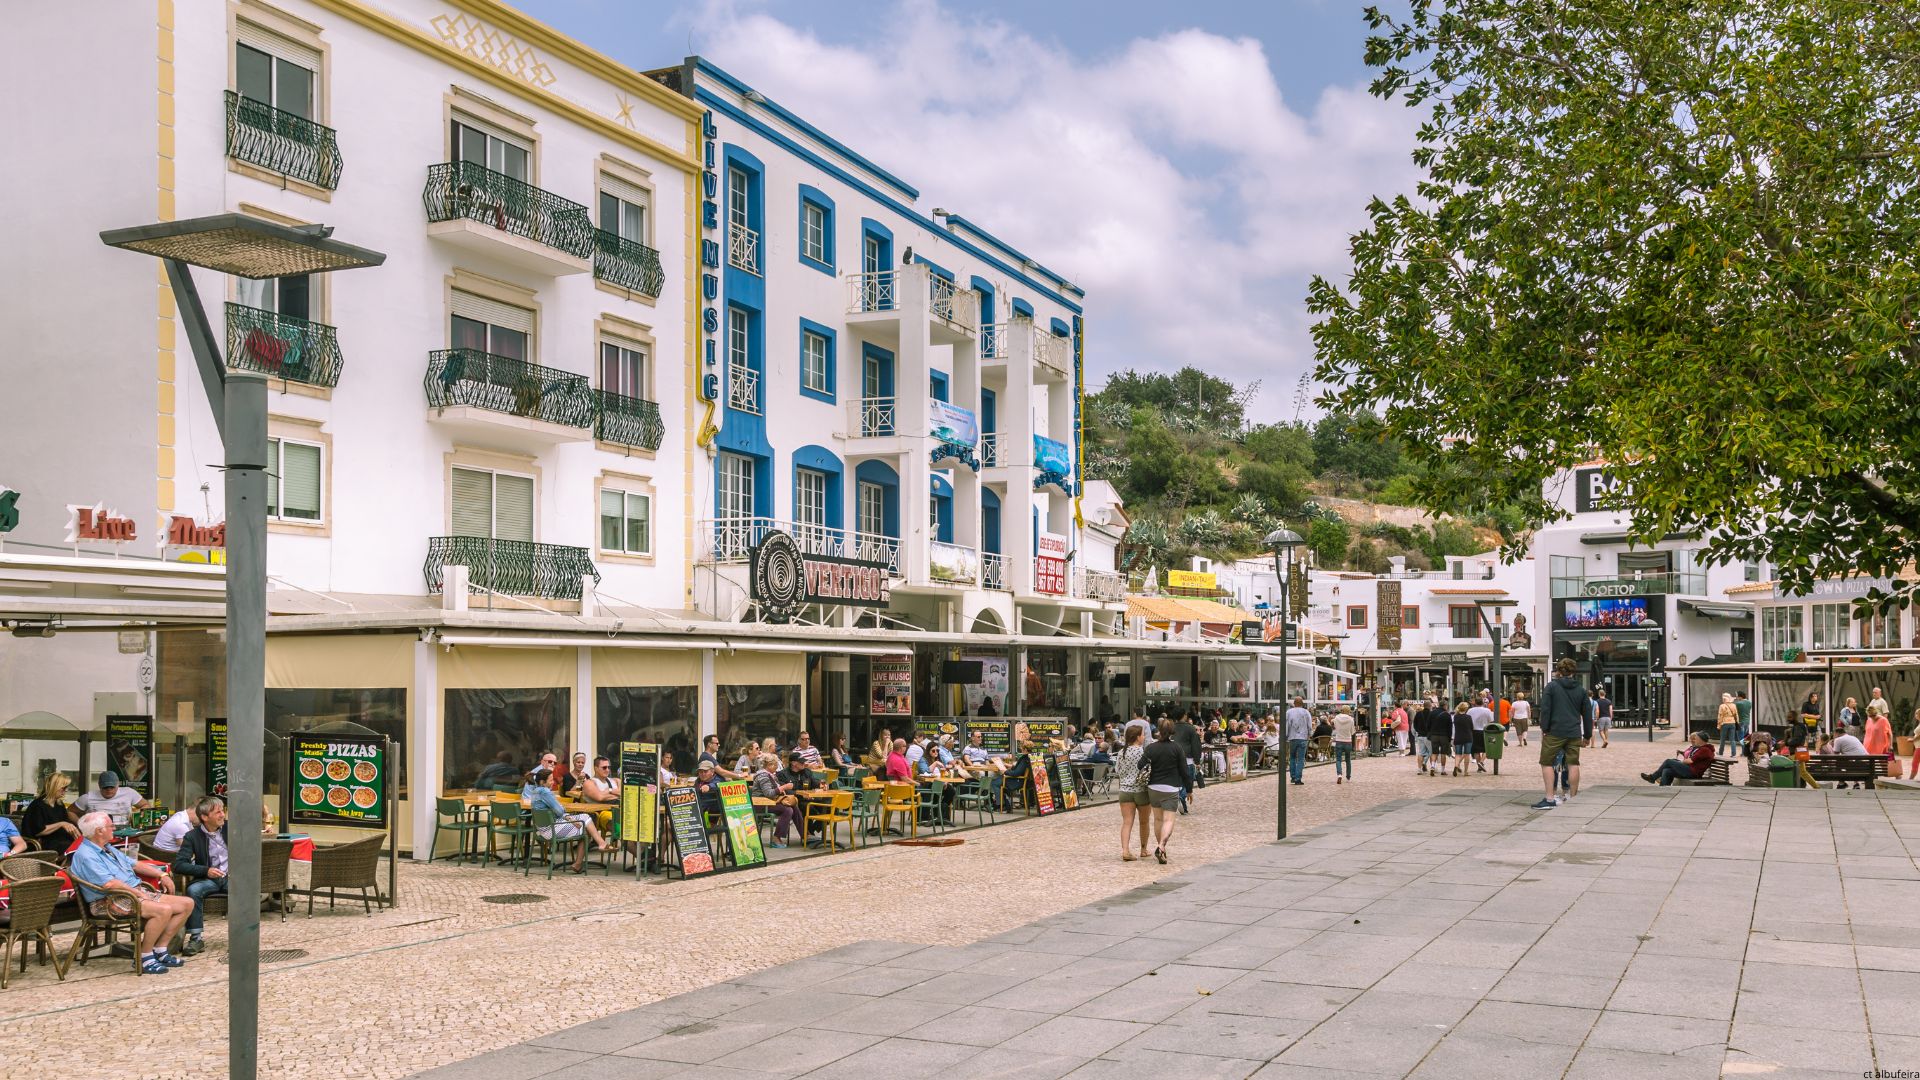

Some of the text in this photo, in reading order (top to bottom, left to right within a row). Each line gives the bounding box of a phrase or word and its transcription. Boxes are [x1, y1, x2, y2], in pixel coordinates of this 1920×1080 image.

[702, 109, 720, 400] LIVE MUSIC
[77, 508, 138, 541] Live
[803, 559, 880, 601] VERTIGO
[1291, 564, 1299, 601] BRAVO
[1583, 584, 1636, 596] ROOFTOP
[1846, 581, 1865, 594] PIZZA
[1381, 592, 1398, 605] STEAK
[872, 672, 910, 681] LIVE MUSIC
[300, 742, 328, 750] Freshly
[327, 743, 377, 758] PIZZAS
[720, 784, 748, 797] MOJITO
[669, 793, 697, 805] PIZZAS
[726, 796, 748, 806] MADNESS
[337, 808, 364, 819] Take Away
